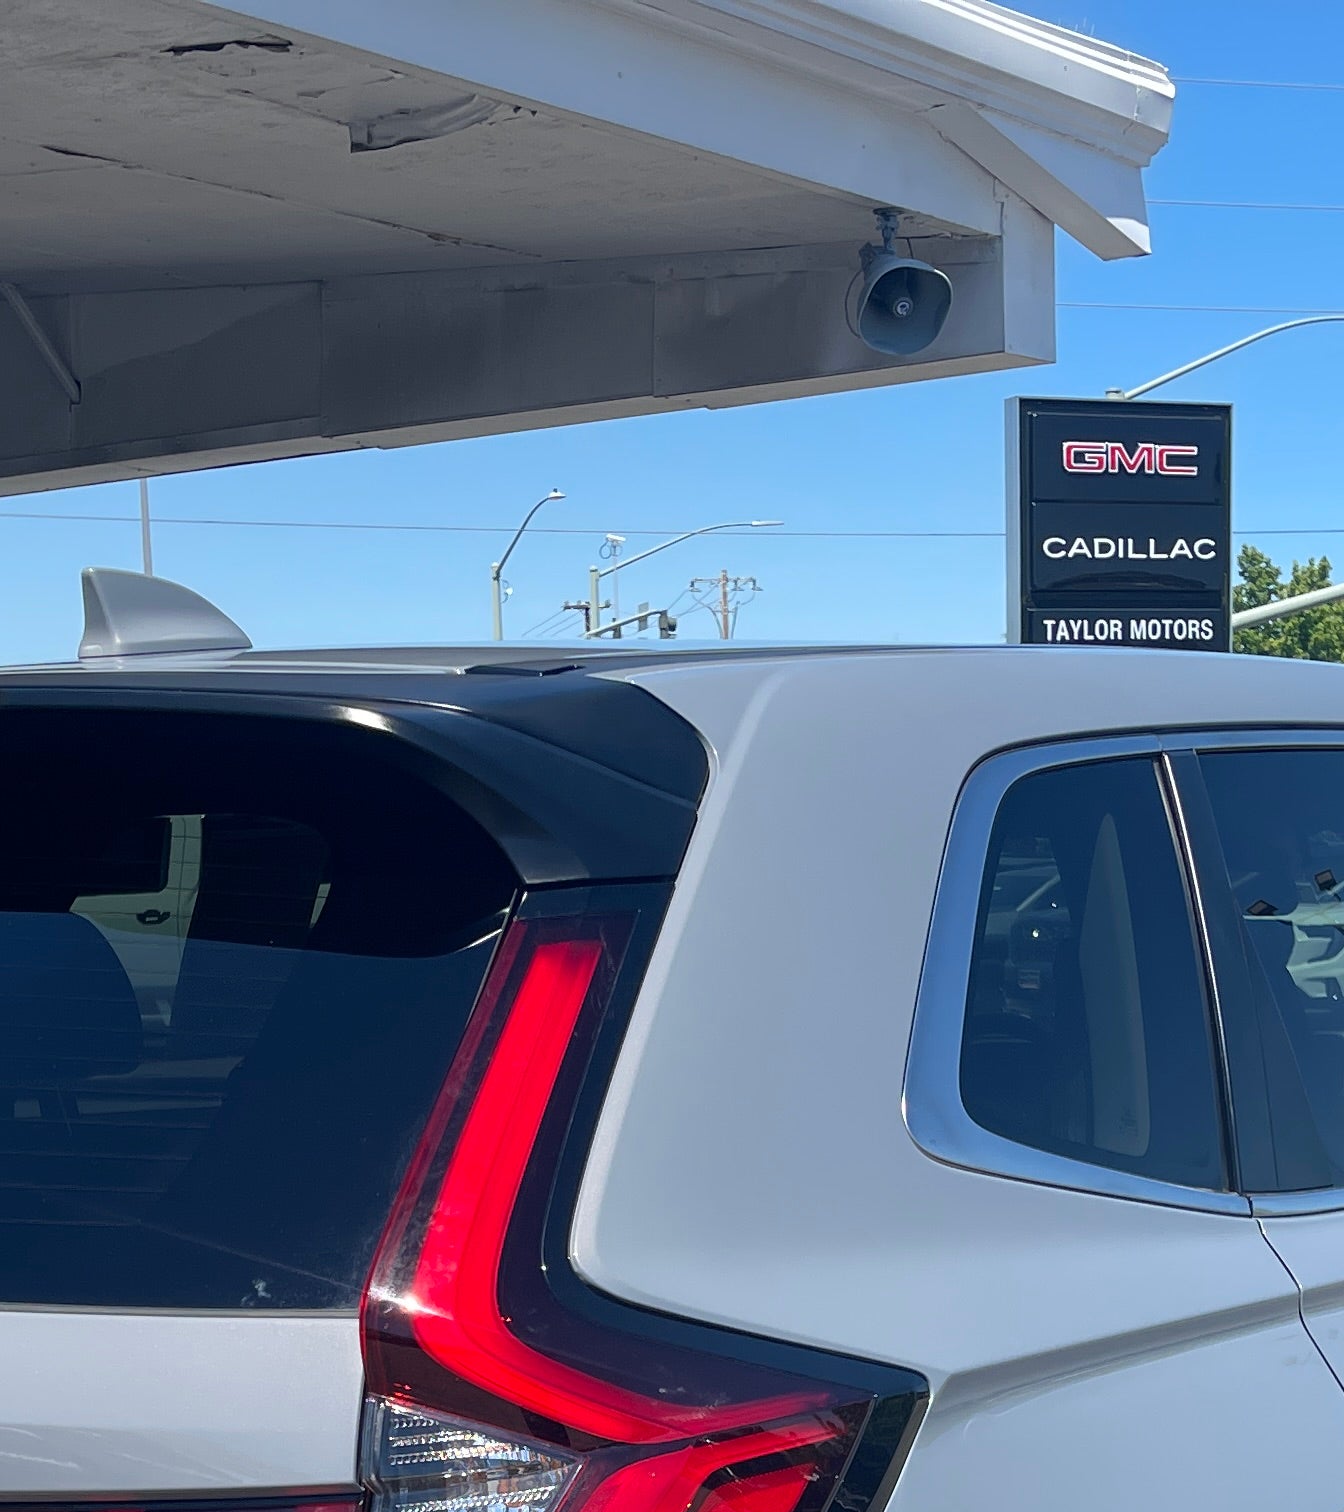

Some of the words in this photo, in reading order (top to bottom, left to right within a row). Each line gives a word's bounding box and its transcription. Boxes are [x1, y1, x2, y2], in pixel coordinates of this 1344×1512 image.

[1062, 440, 1199, 476] GMC
[1042, 537, 1217, 560] CADILLAC
[1042, 618, 1123, 642] TAYLOR
[1129, 618, 1214, 641] MOTORS
